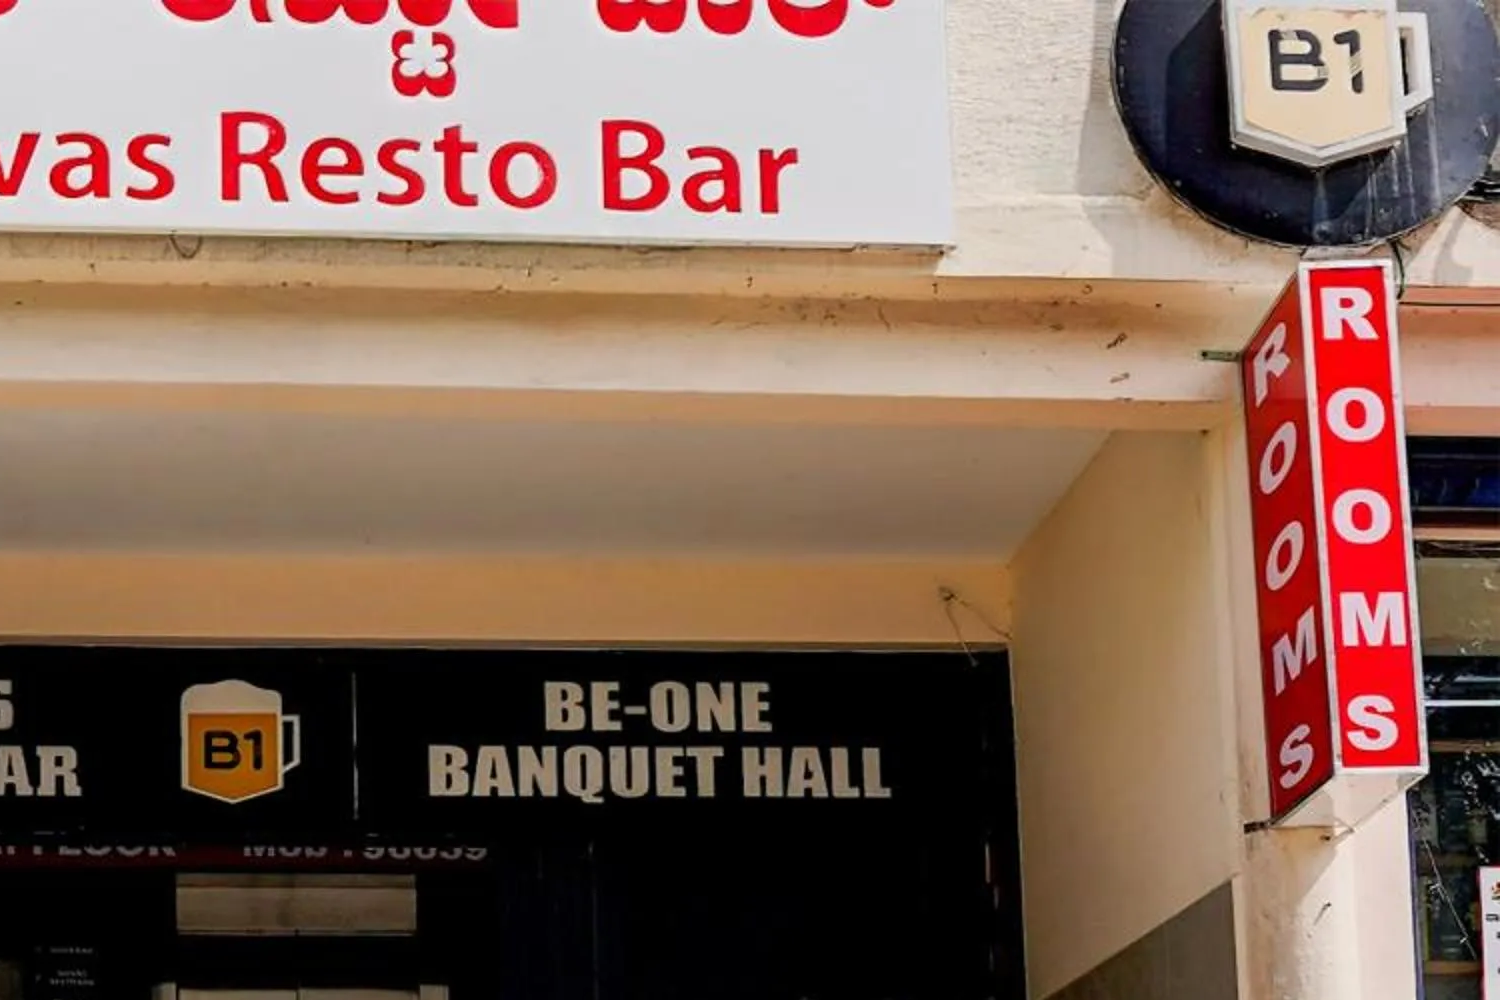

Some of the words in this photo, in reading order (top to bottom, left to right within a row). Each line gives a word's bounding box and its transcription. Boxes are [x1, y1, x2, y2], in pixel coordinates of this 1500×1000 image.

[1267, 28, 1365, 94] B1
[220, 111, 559, 210] Resto
[601, 119, 799, 215] Bar
[1319, 286, 1407, 753] ROOMS
[1252, 321, 1319, 791] ROOMS
[544, 681, 774, 733] BE-ONE
[203, 729, 264, 771] B1
[428, 744, 725, 803] BANQUET
[742, 746, 892, 798] HALL
